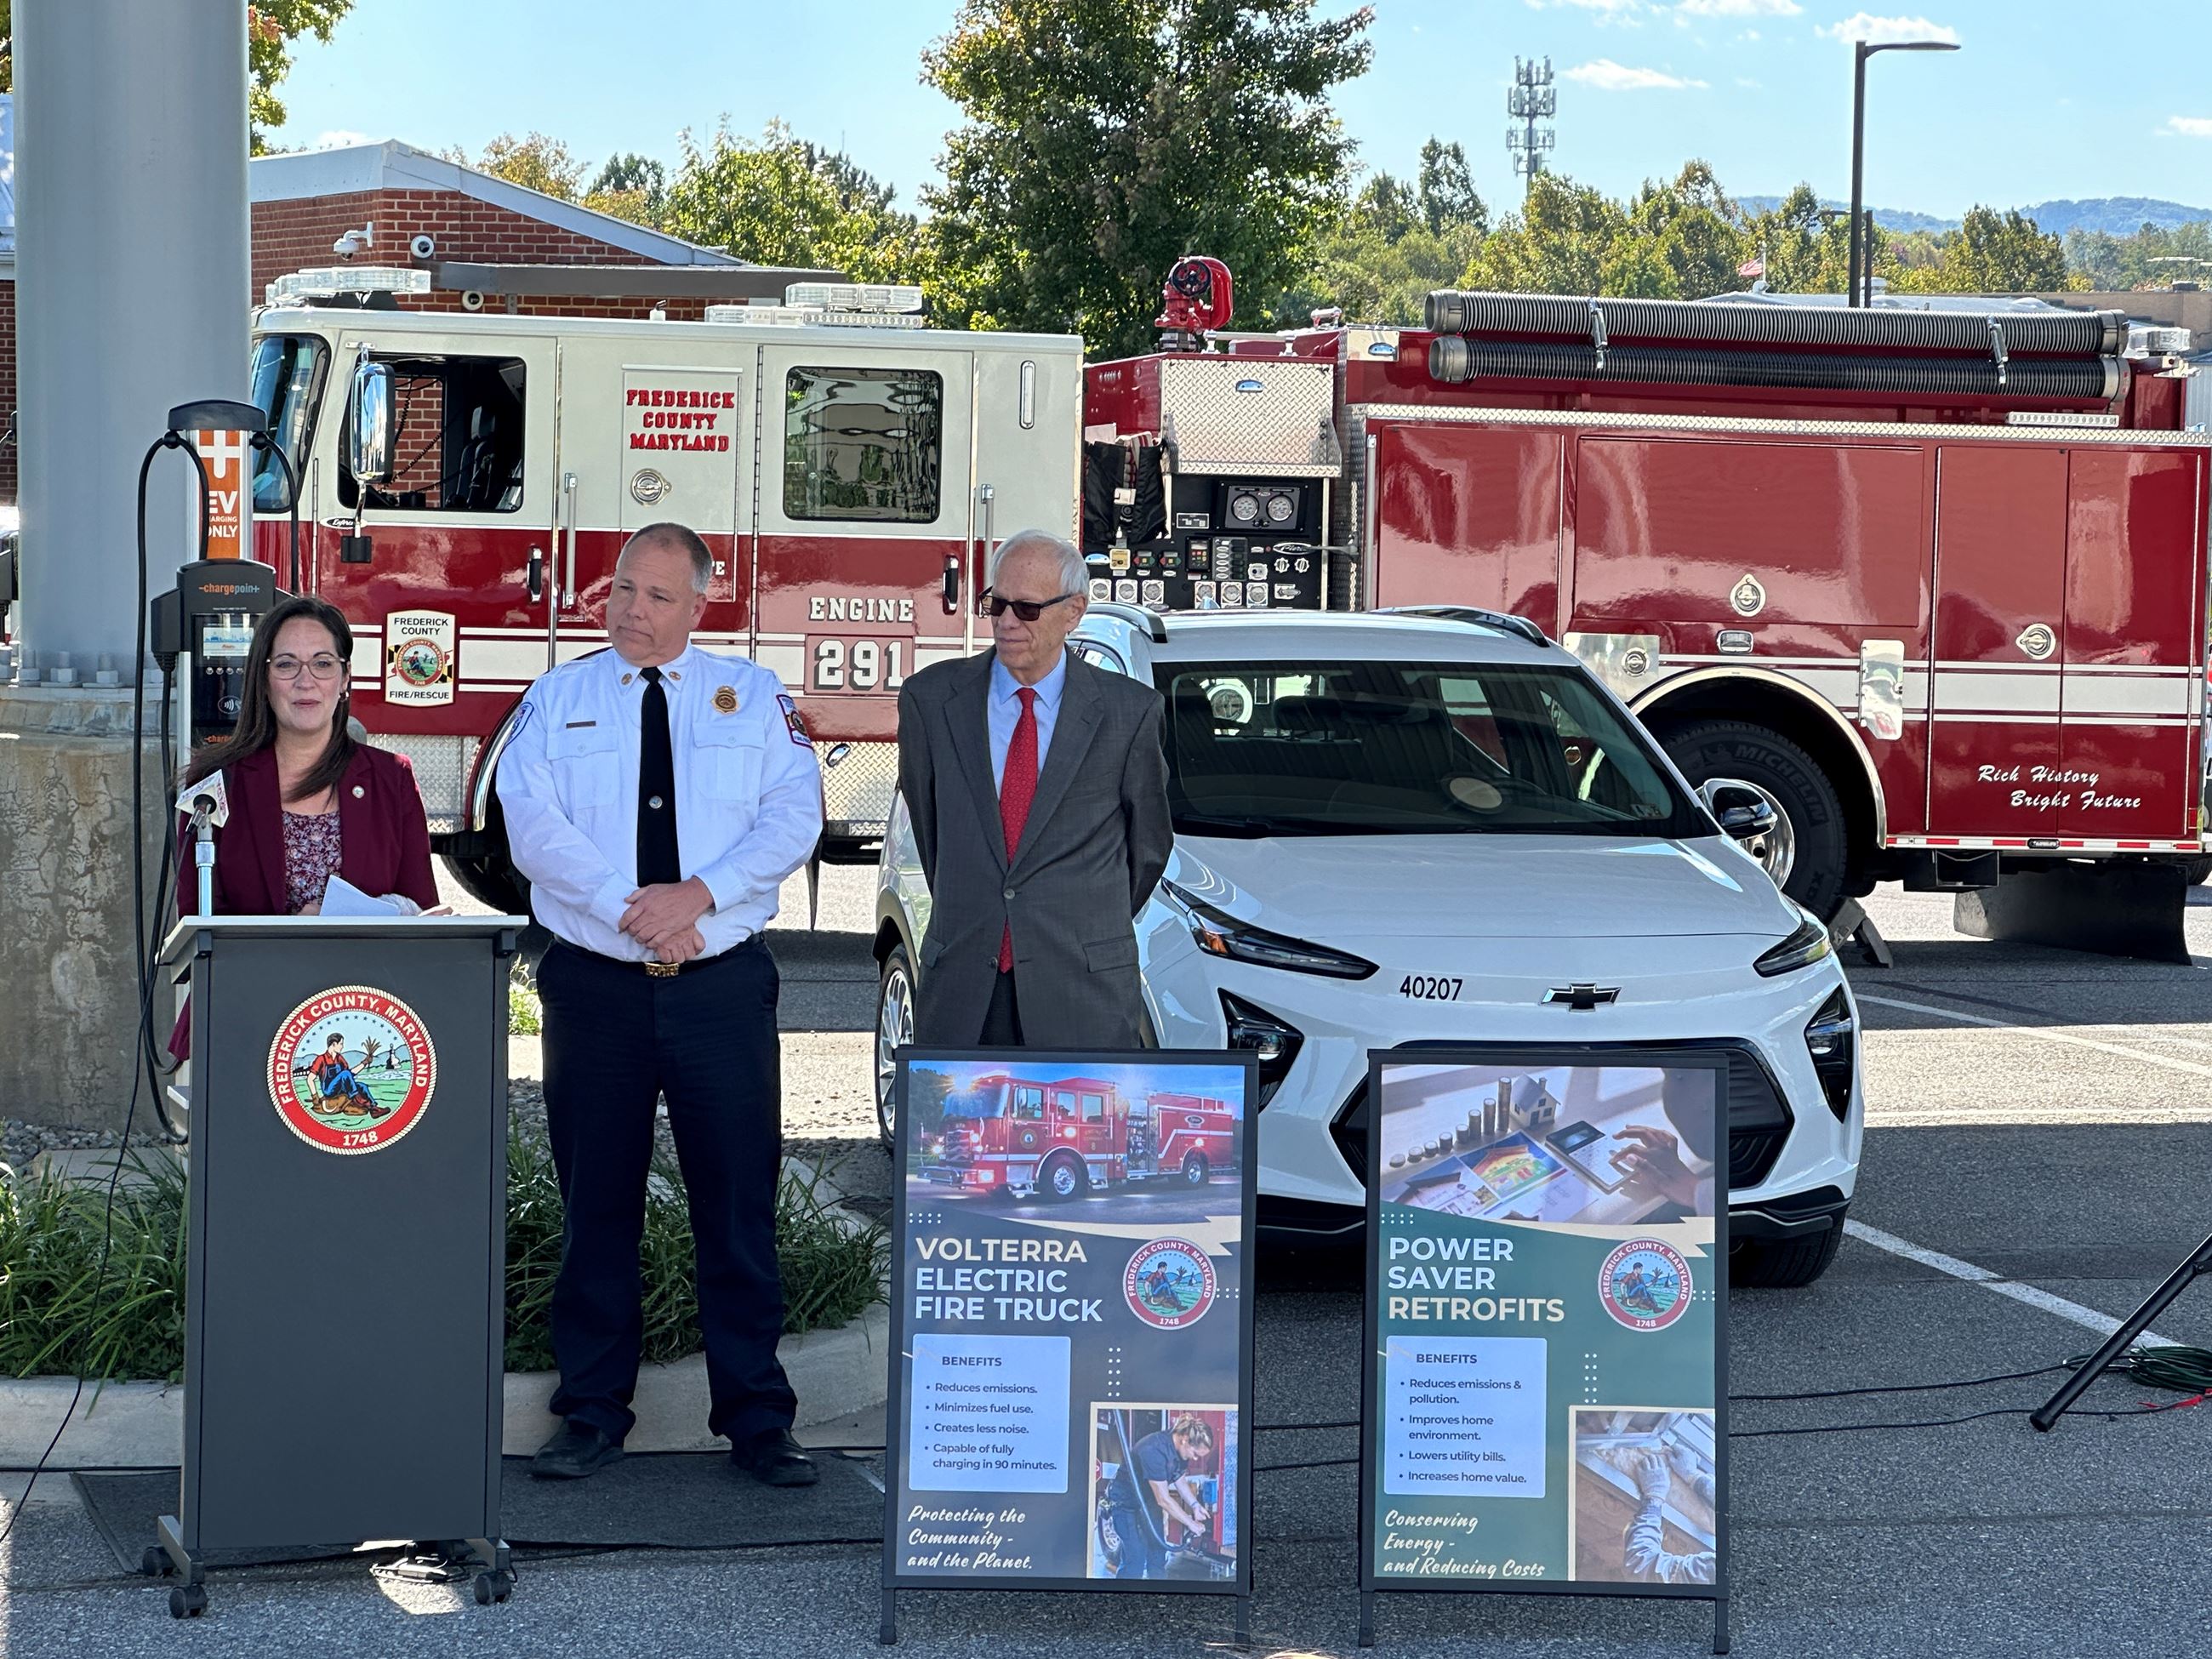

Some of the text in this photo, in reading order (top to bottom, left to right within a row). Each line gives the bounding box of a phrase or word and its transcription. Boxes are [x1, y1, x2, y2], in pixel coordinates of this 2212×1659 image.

[626, 389, 735, 408] FREDERICK
[643, 412, 717, 430] COUNTY
[630, 433, 729, 452] MARYLAND
[809, 597, 914, 622] ENGINE
[394, 618, 448, 626] FREDERICK
[402, 627, 440, 636] COUNTY
[814, 640, 904, 691] 291
[390, 691, 449, 699] FIRE/RESCUE
[1735, 744, 1827, 824] MICHELIN
[1978, 764, 2099, 787] Rich History
[2010, 790, 2141, 812] Bright Future
[1400, 975, 1463, 1001] 40207
[276, 995, 428, 1104] FREDERICK COUNTY, MARYLAND
[343, 1131, 378, 1146] 1748
[915, 1237, 1088, 1263] VOLTERRA
[1389, 1237, 1514, 1261] POWER
[1127, 1241, 1212, 1298] FREDERICK COUNTY, MARYLAND
[1388, 1265, 1496, 1290] SAVER
[1603, 1242, 1689, 1300] FREDERICK COUNTY, MARYLAND
[916, 1267, 1068, 1293] ELECTRIC
[915, 1296, 1103, 1322] FIRE TRUCK
[1388, 1297, 1565, 1322] RETROFITS
[1159, 1317, 1180, 1325] 1748
[942, 1356, 1002, 1366] BENEFITS
[1416, 1354, 1478, 1364] BENEFITS
[935, 1382, 1038, 1394] Reduces emissions.
[1410, 1378, 1522, 1389] Reduces emissions &
[934, 1403, 988, 1413] Minimizes
[989, 1403, 1010, 1413] fuel
[1409, 1394, 1460, 1405] pollution.
[933, 1422, 1029, 1434] Creates less noise.
[1409, 1414, 1494, 1426] Improves home
[1409, 1430, 1481, 1440] environment.
[933, 1443, 1014, 1456] Capable of fully
[1408, 1451, 1506, 1463] Lowers utility bills.
[932, 1458, 1057, 1470] charging in 90 minutes.
[1408, 1471, 1527, 1483] Increases home value.
[907, 1505, 1026, 1529] Protecting the
[1384, 1509, 1479, 1535] Conserving
[908, 1528, 1003, 1550] Community
[1383, 1532, 1445, 1556] Energy
[907, 1551, 1033, 1570] and the Planet.
[1383, 1557, 1546, 1580] and Reducing Costs
